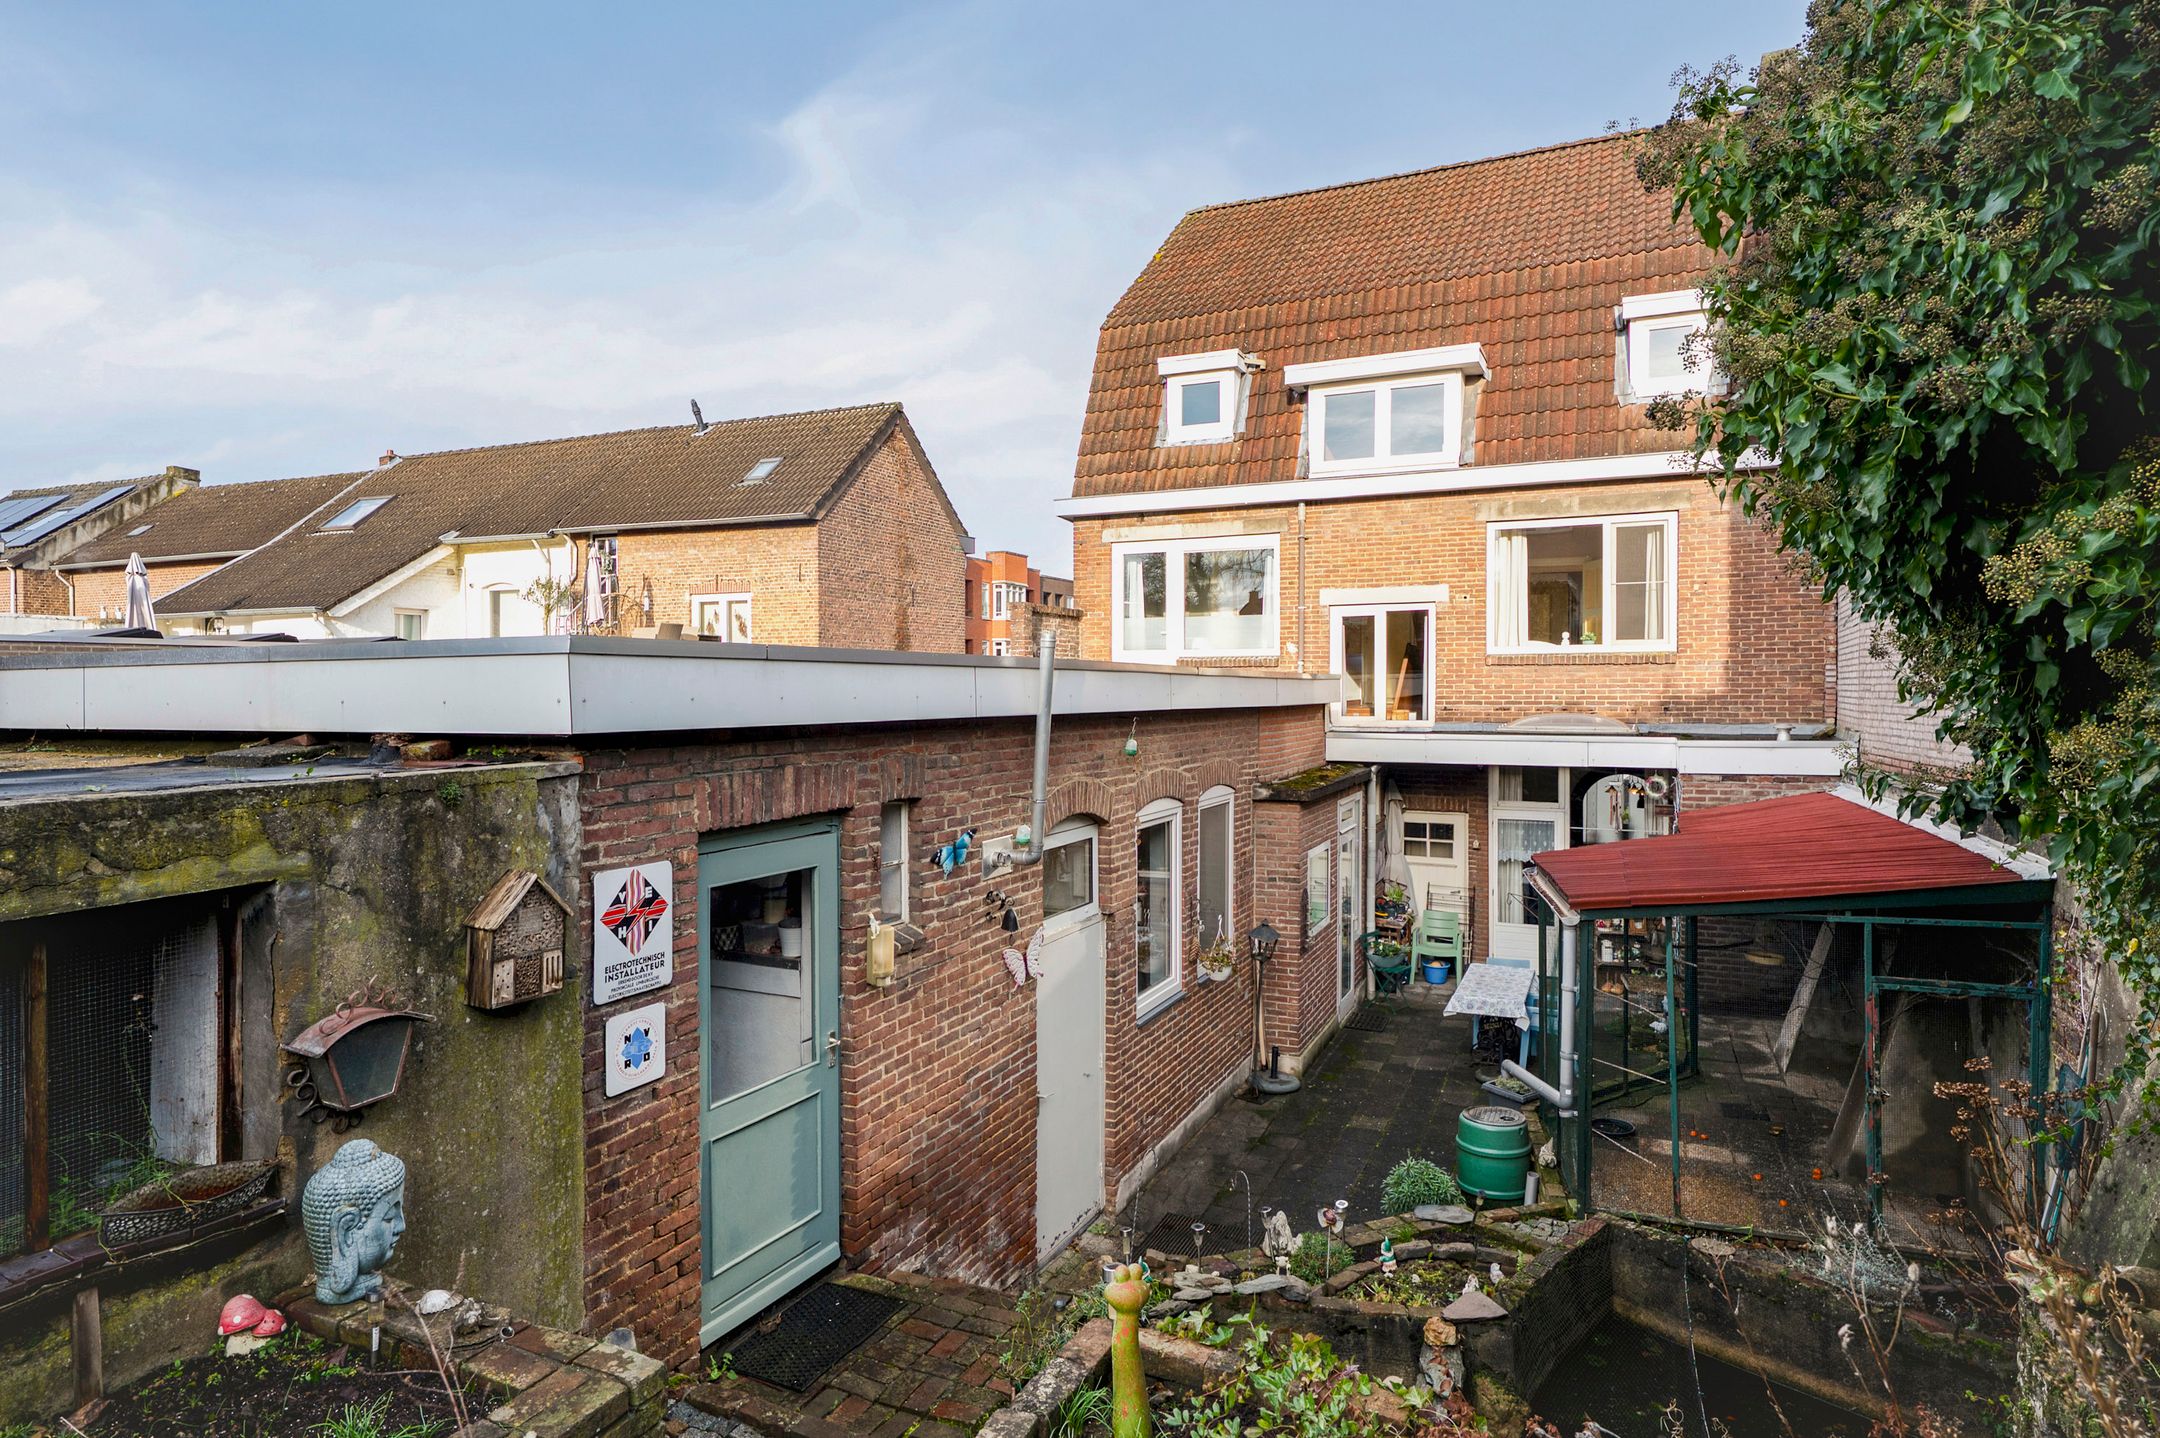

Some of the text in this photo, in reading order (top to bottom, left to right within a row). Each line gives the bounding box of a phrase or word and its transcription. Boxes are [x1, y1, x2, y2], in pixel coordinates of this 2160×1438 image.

[618, 886, 653, 903] V E
[618, 926, 627, 939] H
[604, 951, 665, 974] ELECTROTECHNISCH
[604, 960, 665, 983] INSTALLATEUR
[624, 1028, 650, 1044] N V
[624, 1059, 631, 1069] R
